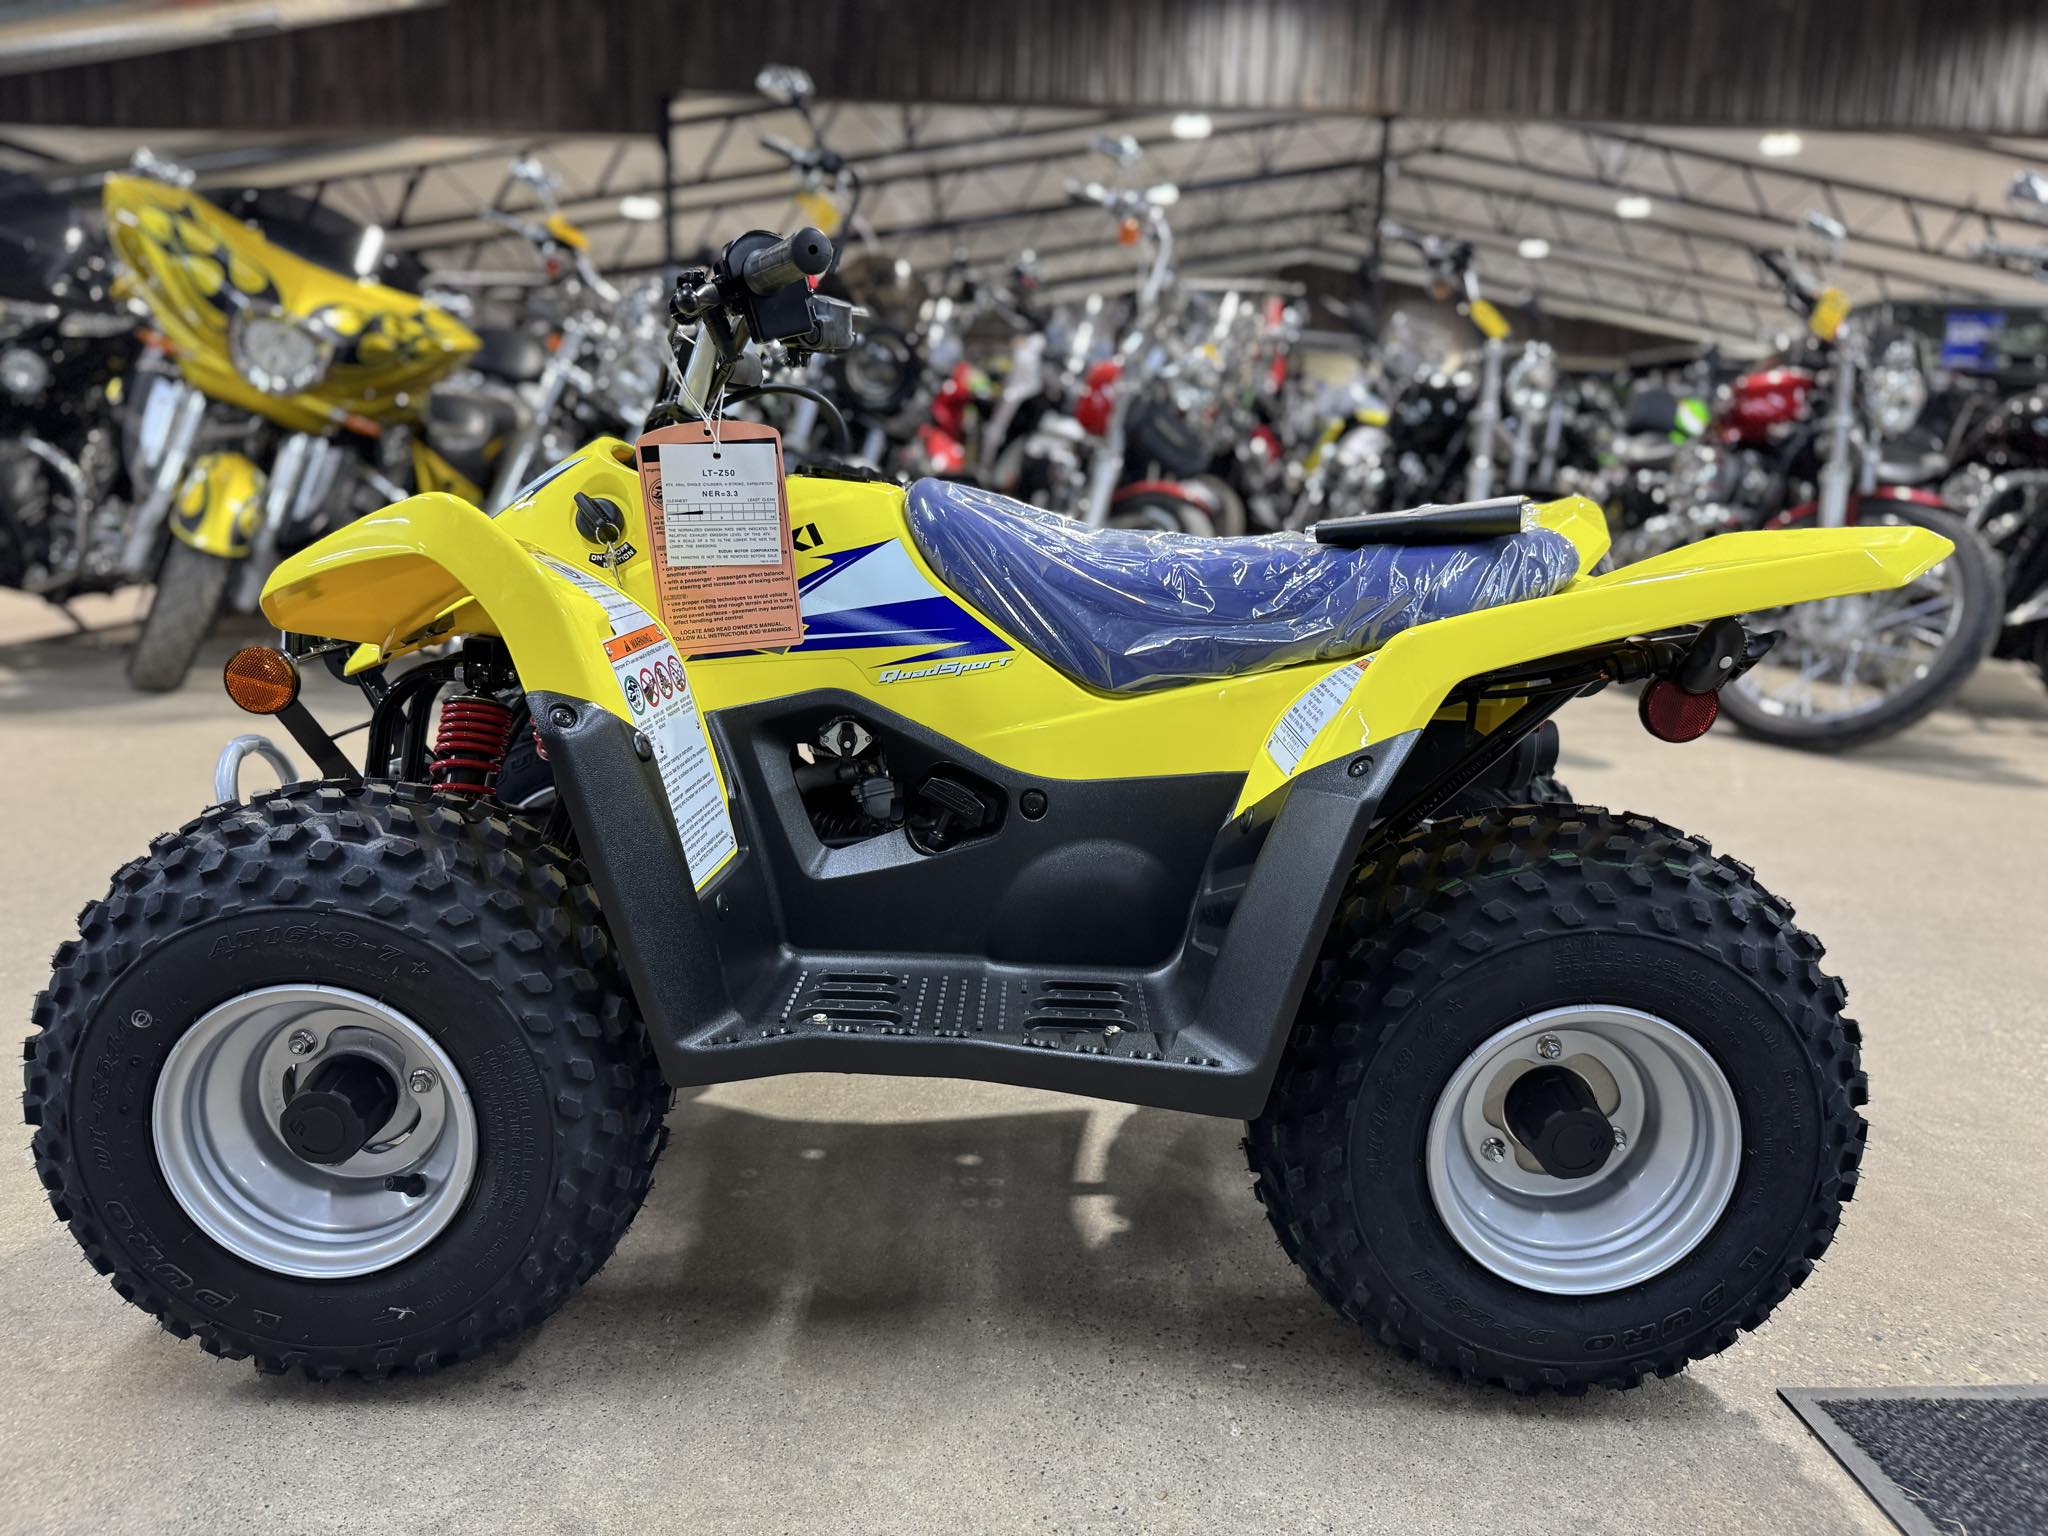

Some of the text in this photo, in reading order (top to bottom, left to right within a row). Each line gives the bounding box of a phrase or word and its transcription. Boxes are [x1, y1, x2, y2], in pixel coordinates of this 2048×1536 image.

[615, 544, 630, 556] OFF
[631, 633, 652, 648] WARNING
[879, 656, 1013, 684] QuadSport
[104, 1200, 238, 1312] DURO
[1583, 1279, 1727, 1354] DURO
